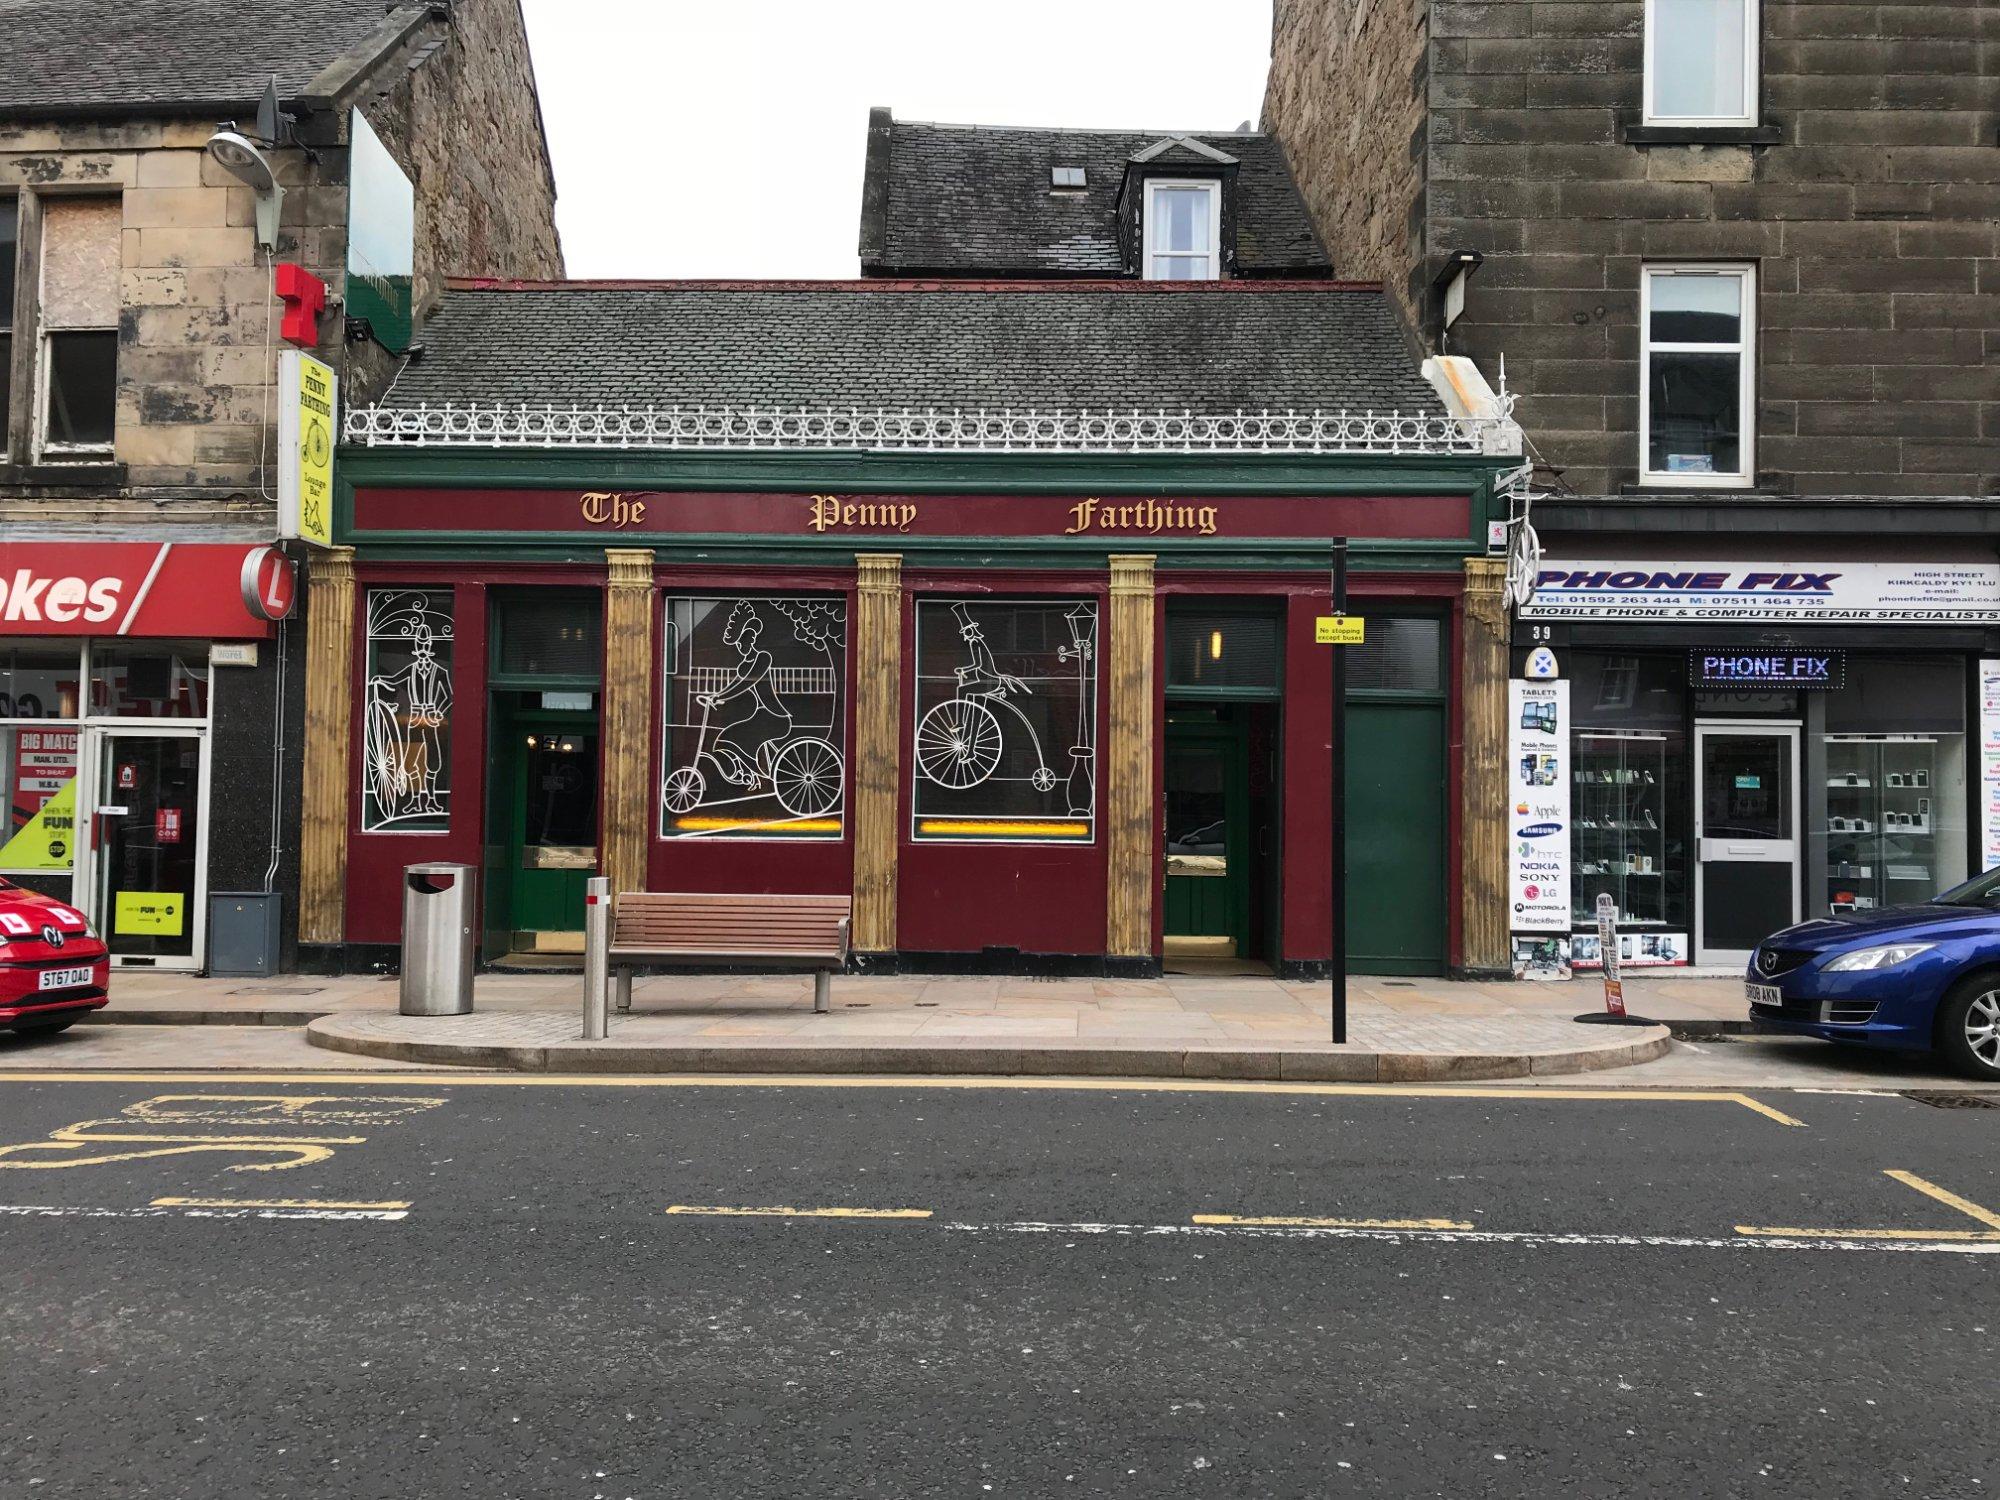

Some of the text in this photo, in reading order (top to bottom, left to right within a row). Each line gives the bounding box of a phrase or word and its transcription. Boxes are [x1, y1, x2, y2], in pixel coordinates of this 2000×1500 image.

[311, 366, 321, 377] The
[305, 375, 326, 397] PENNY
[300, 391, 330, 418] FARTHING
[304, 472, 326, 490] Lounge
[309, 485, 321, 497] Bar
[580, 491, 1218, 535] The Penny Farthing
[1529, 571, 1843, 590] PHONE FIX
[0, 568, 123, 622] kes
[1536, 595, 1565, 604] Tel:
[1569, 596, 1616, 604] 01592
[1621, 596, 1648, 604] 263
[1711, 597, 1757, 605] 07511
[1531, 607, 1999, 619] MOBILE PHONE & COMPUTER REPAIR SPECIALISTS
[1703, 657, 1830, 676] PHONE FIX
[21, 733, 41, 750] BIG
[1534, 804, 1561, 819] Apple
[43, 817, 73, 829] FUN
[1522, 826, 1558, 834] SAMSUNG
[1520, 862, 1560, 870] NOKIA
[1519, 873, 1560, 881] SONY
[1543, 888, 1557, 898] LG
[1525, 916, 1564, 925] BlackBerry
[43, 971, 69, 986] ST67
[1762, 986, 1778, 1003] AKN
